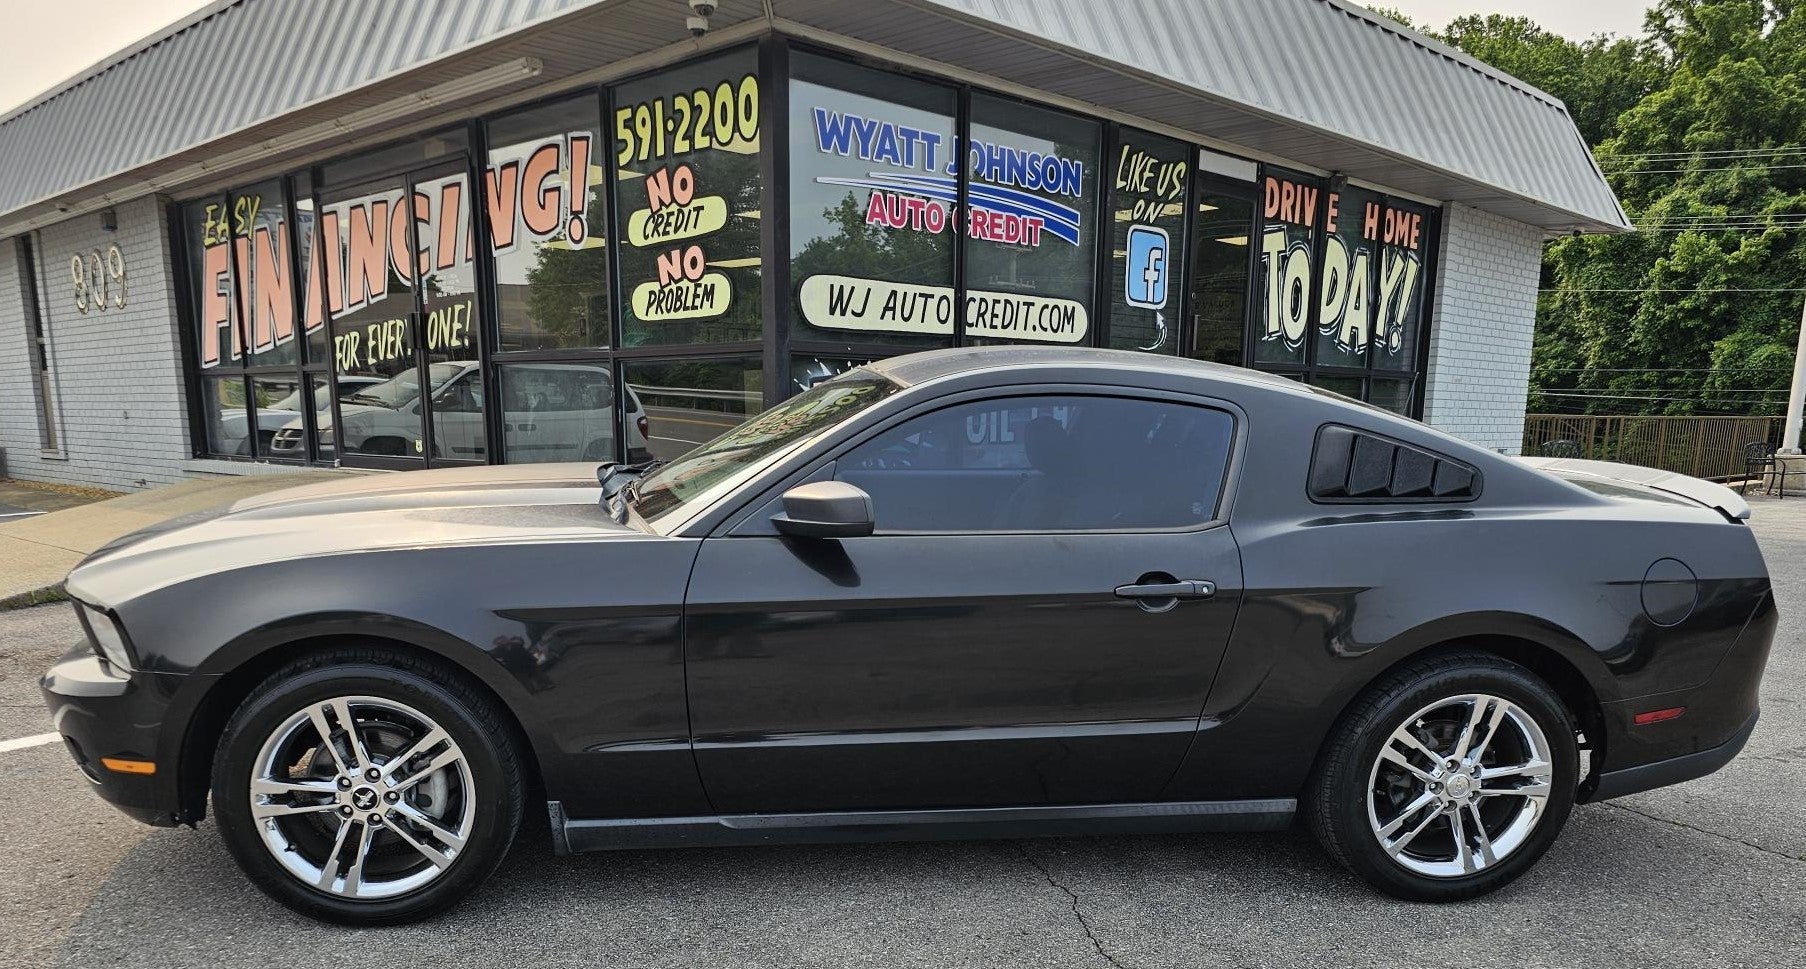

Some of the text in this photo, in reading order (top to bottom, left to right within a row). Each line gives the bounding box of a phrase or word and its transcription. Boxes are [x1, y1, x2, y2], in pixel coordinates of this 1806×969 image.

[813, 106, 1083, 198] WYATT JOHNSON
[1116, 144, 1187, 200] LIKE US
[645, 164, 695, 214] NO
[866, 191, 946, 235] AUTO
[1132, 199, 1164, 223] ON
[1264, 176, 1421, 250] DRIVE HOME
[203, 195, 262, 246] EASY
[642, 205, 705, 240] CREDIT
[202, 131, 592, 368] FINANCING!
[656, 245, 706, 288] NO
[71, 246, 129, 314] 809
[645, 283, 716, 317] PROBLEM
[1261, 224, 1421, 357] TODAY!
[828, 283, 1077, 334] WJ AUTO CREDIT.COM
[334, 300, 472, 373] FOR EVERONE!
